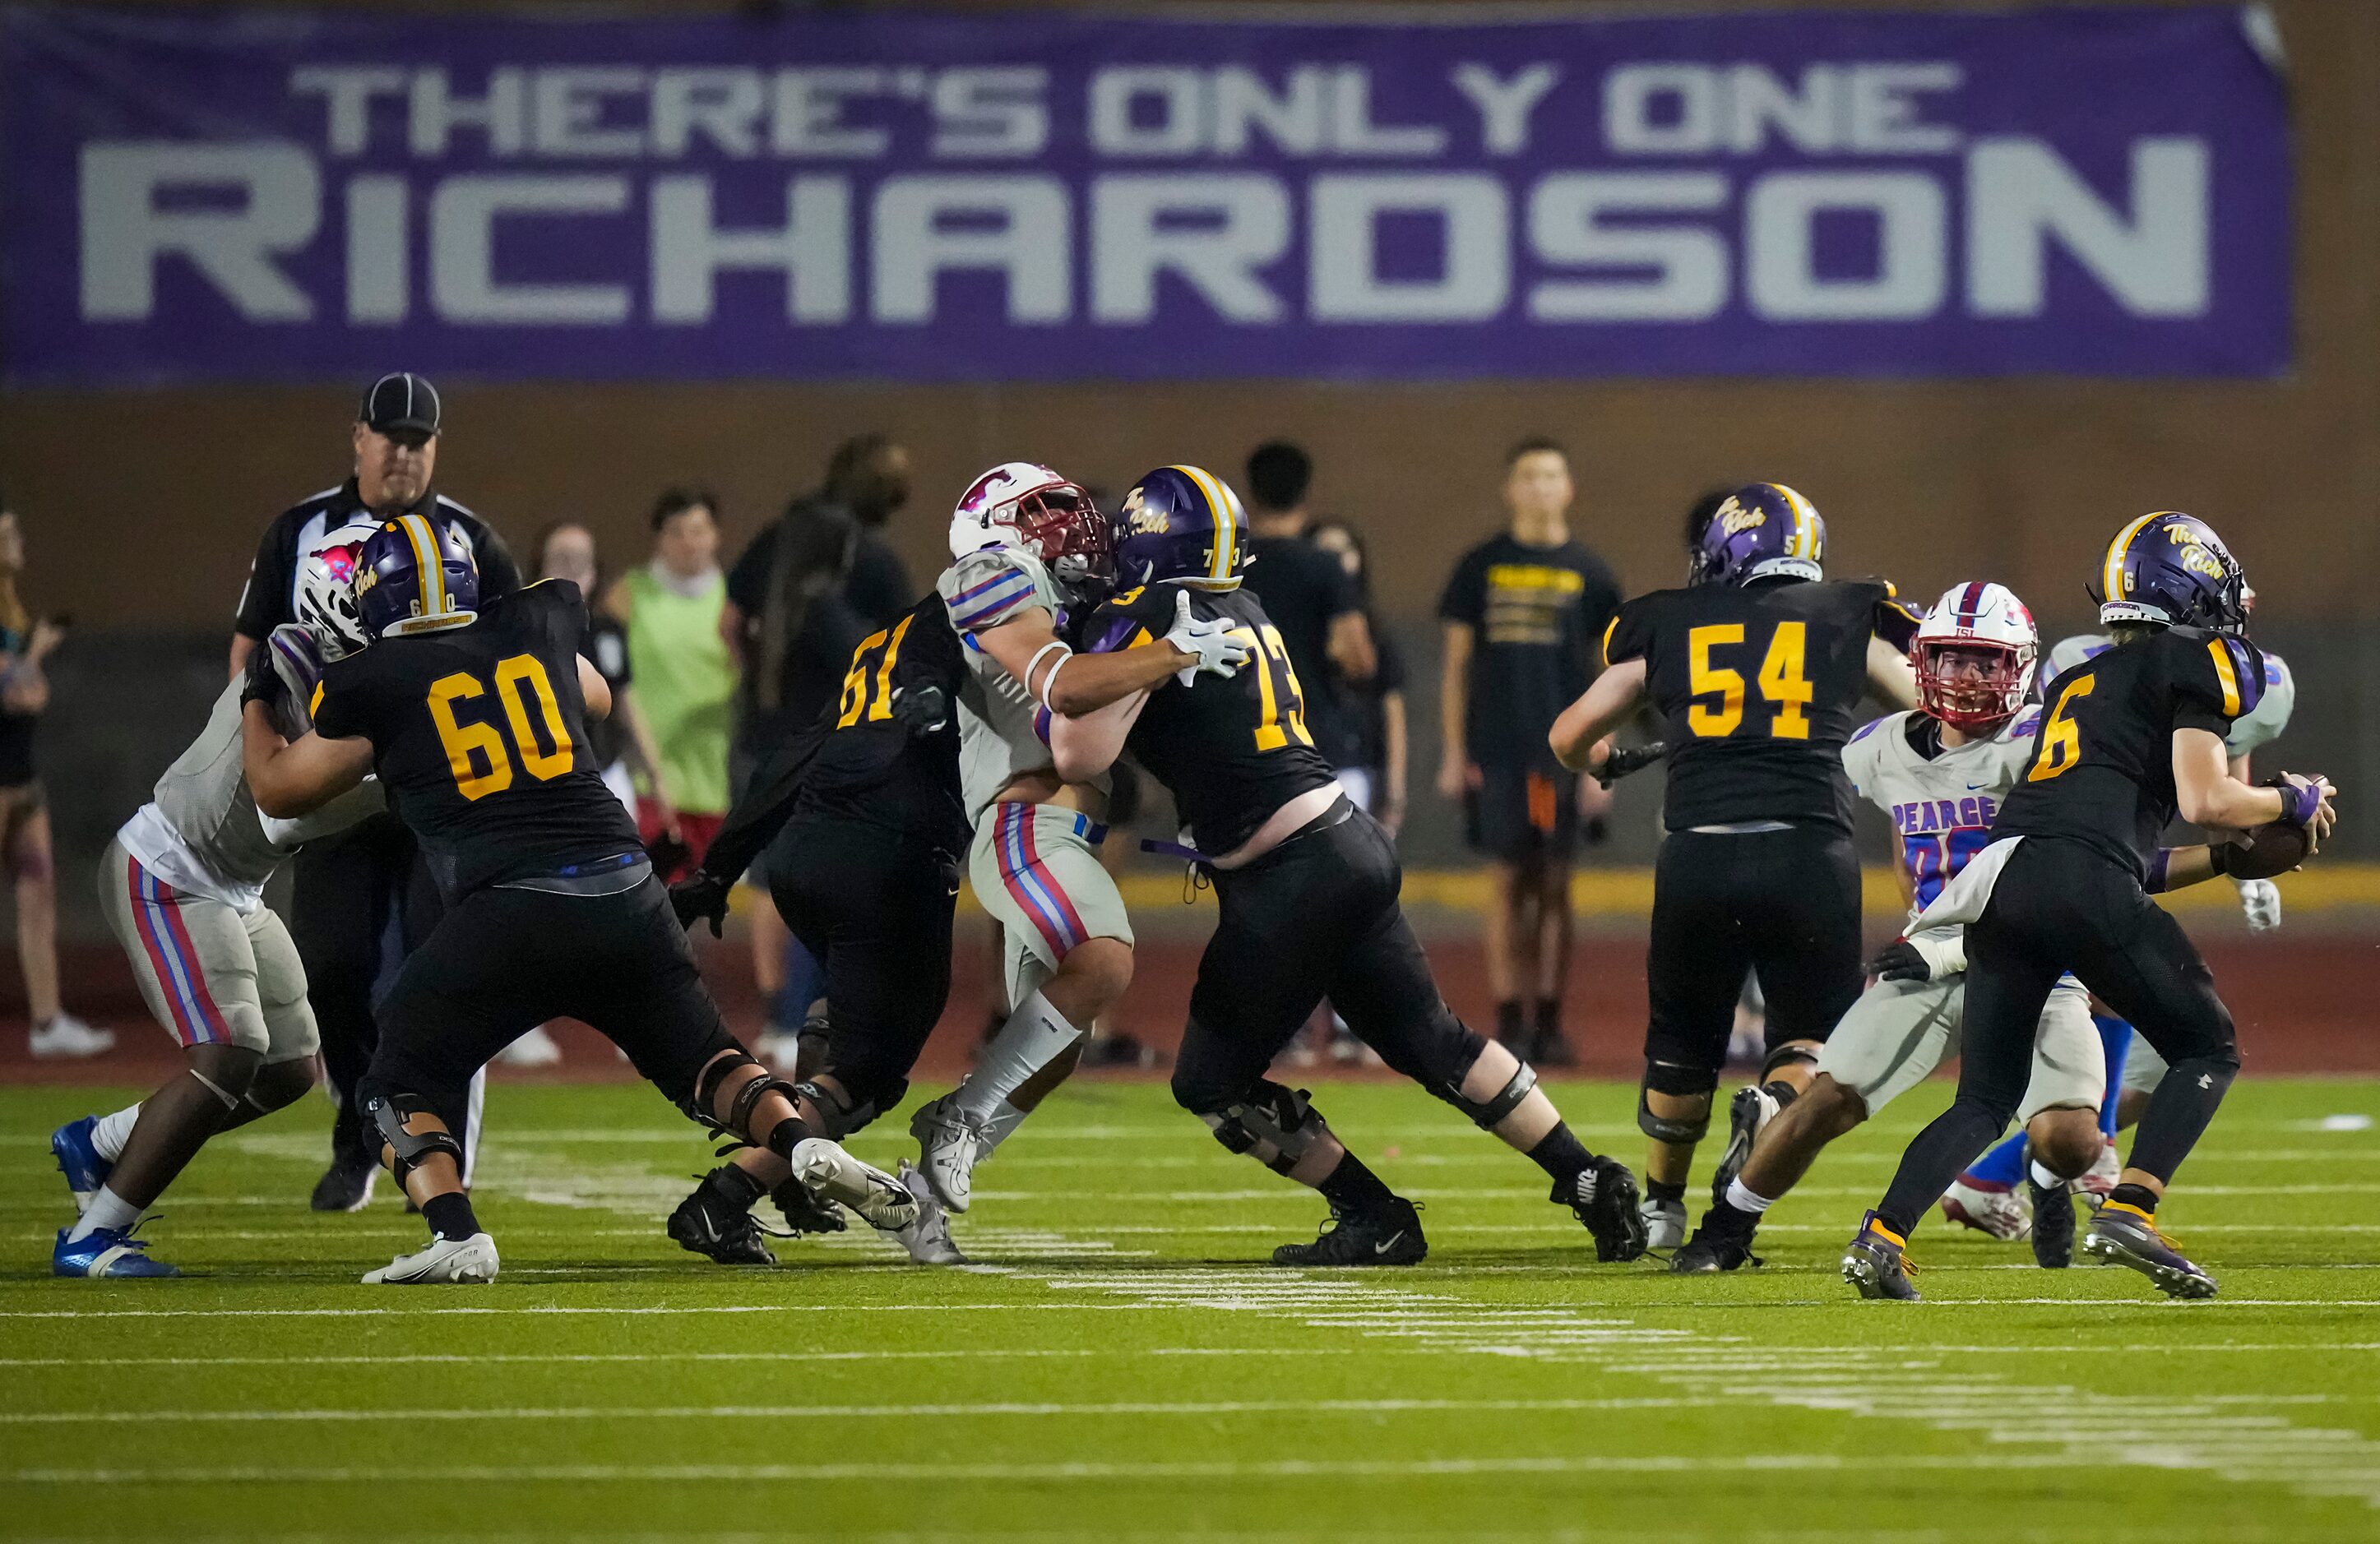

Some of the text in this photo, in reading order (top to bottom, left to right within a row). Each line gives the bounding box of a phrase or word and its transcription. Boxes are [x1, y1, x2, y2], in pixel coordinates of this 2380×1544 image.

[289, 63, 1964, 158] THERE'S ONLY ONE
[79, 138, 2211, 326] RICHARDSON
[1721, 506, 1766, 538] Rich
[2163, 524, 2202, 545] The
[2180, 545, 2223, 580] Rich
[2123, 571, 2135, 592] 6
[836, 613, 915, 731] 61
[1224, 623, 1315, 751] 73
[1688, 622, 1813, 740] 54
[427, 653, 574, 802] 60
[2027, 673, 2095, 783] 6
[1892, 796, 1997, 834] PEARCE
[1577, 1168, 1598, 1204] NIKE
